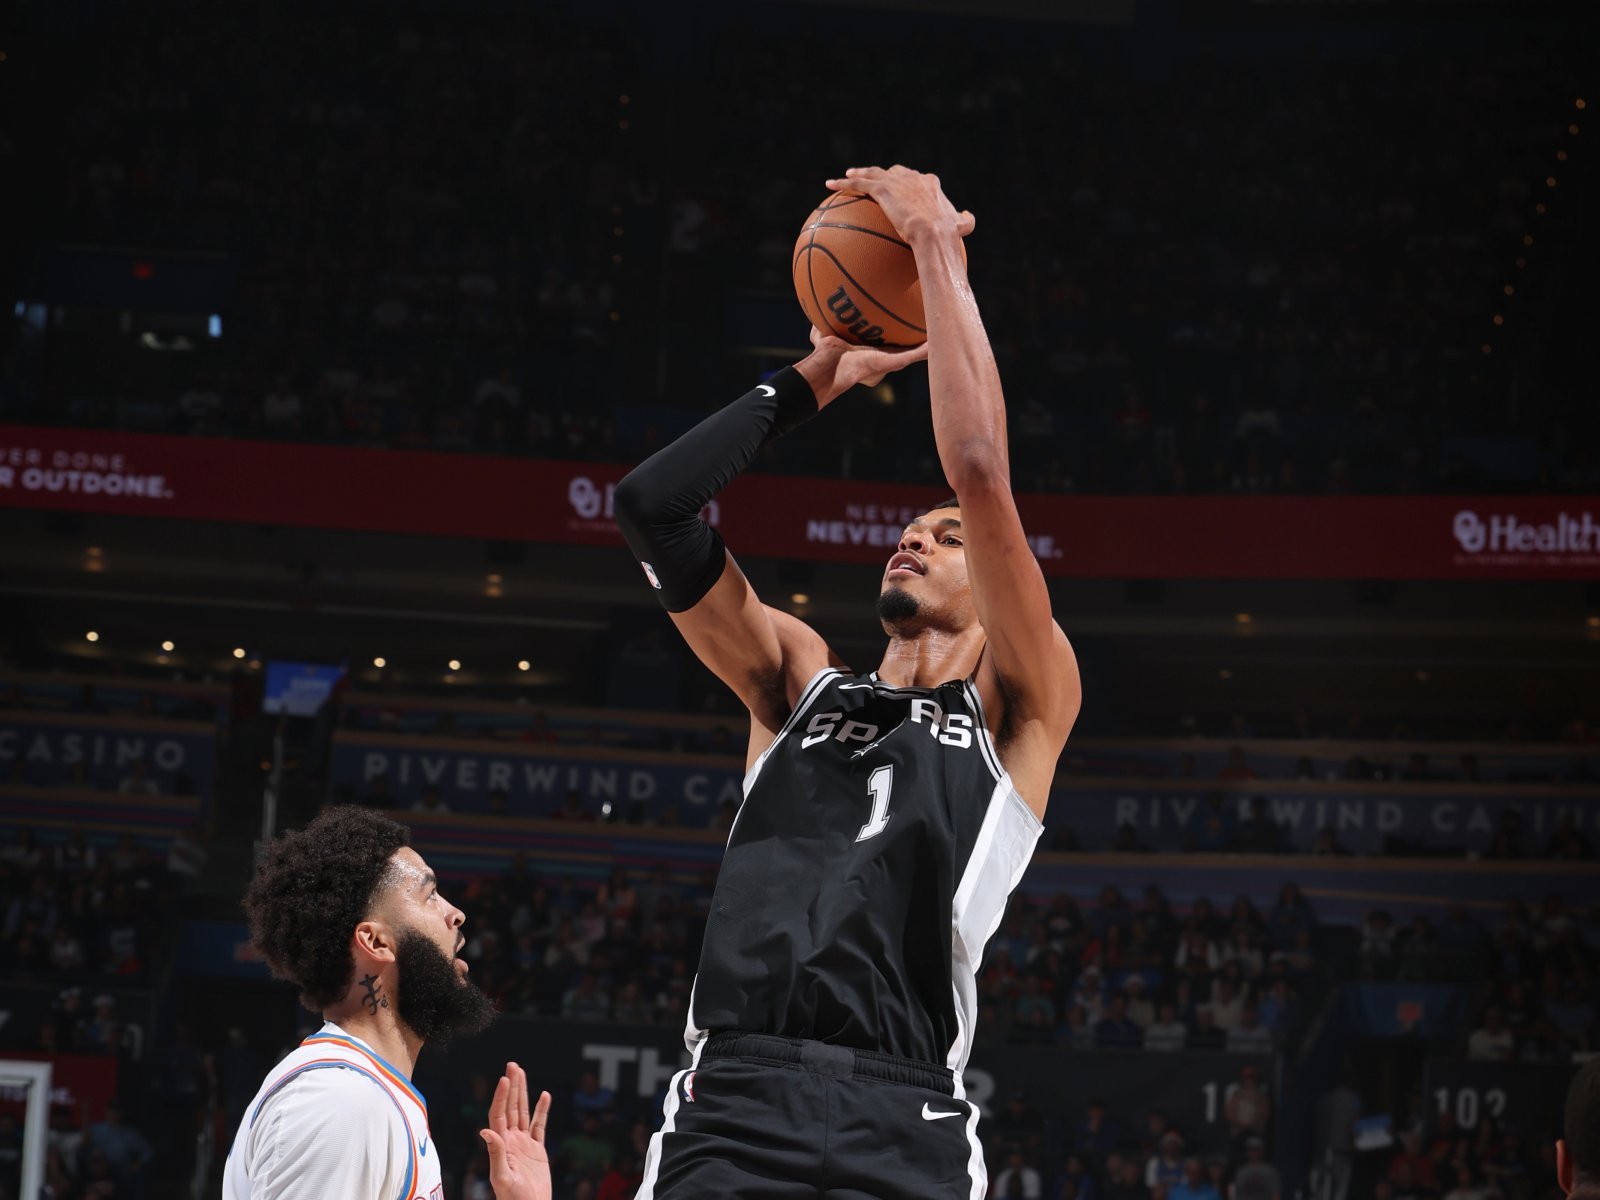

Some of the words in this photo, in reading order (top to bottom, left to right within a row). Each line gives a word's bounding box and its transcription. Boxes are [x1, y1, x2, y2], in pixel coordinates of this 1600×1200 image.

[21, 468, 174, 498] OUTDONE.
[0, 730, 185, 771] CASINO
[854, 763, 894, 843] 1
